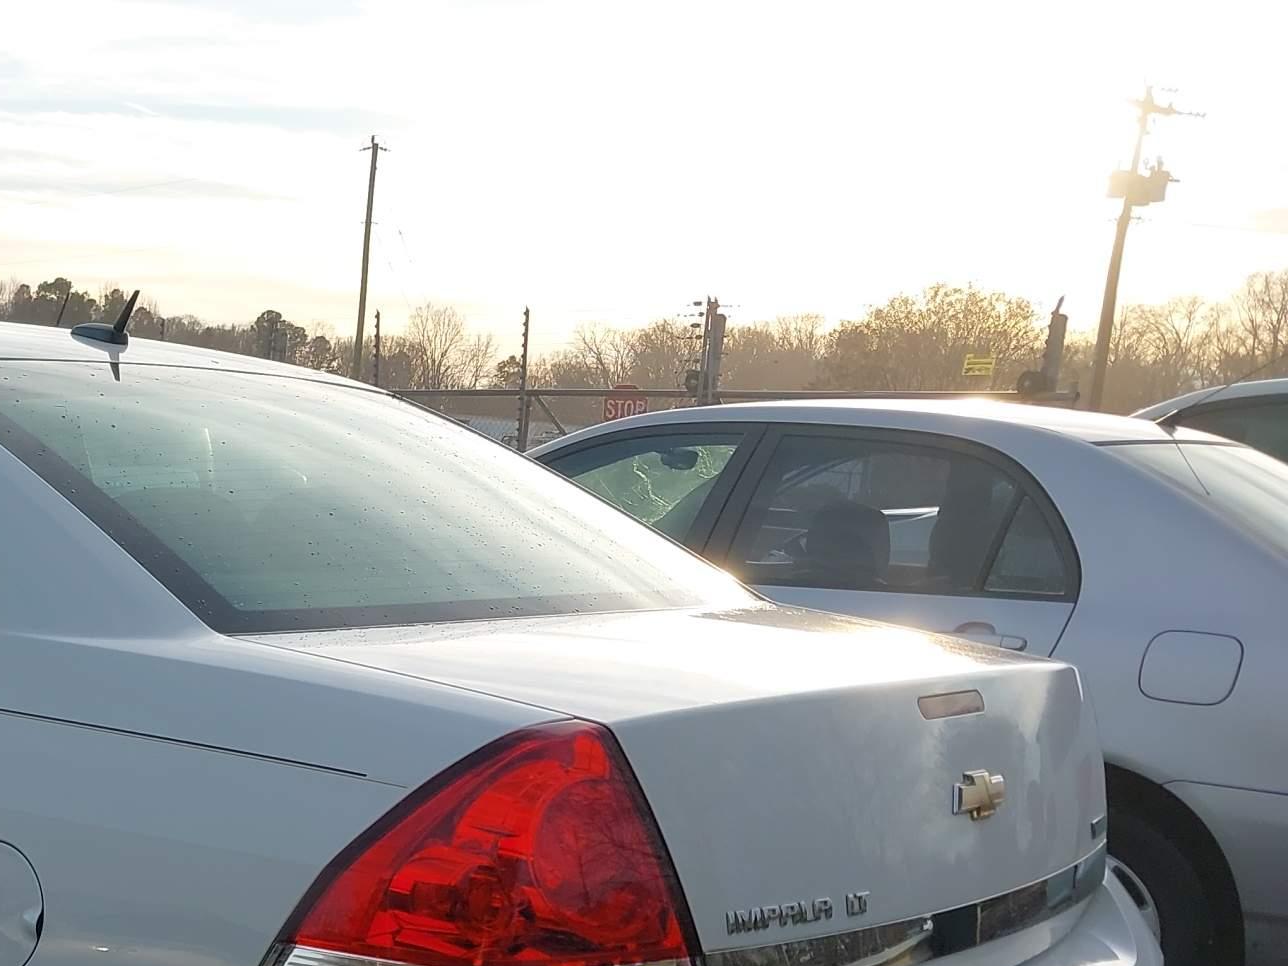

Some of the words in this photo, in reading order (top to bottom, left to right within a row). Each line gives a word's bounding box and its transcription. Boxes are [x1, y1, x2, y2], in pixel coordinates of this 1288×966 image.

[606, 399, 645, 418] STOP
[725, 896, 833, 936] IMPALA
[845, 890, 871, 917] LT
